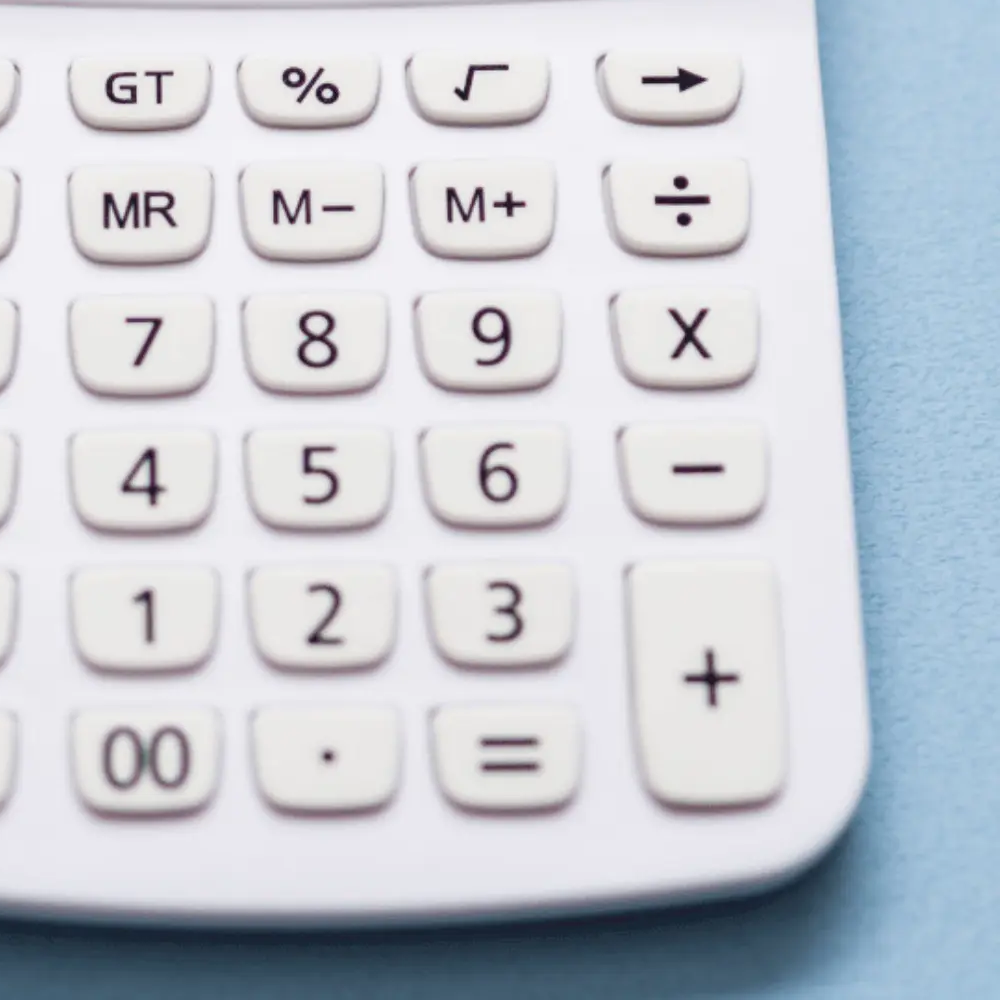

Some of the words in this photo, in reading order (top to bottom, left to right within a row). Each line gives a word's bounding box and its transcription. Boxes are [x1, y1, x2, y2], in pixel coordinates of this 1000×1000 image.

[104, 70, 175, 105] GT
[281, 66, 341, 105] %
[102, 190, 178, 230] MR
[445, 185, 527, 224] M+
[124, 316, 165, 368] 7
[296, 309, 339, 369] 8
[470, 306, 513, 368] 9
[119, 446, 167, 506] 4
[301, 445, 340, 506] 5
[478, 441, 520, 504] 6
[133, 588, 155, 644] 1
[305, 582, 347, 646] 2
[486, 580, 525, 643] 3
[102, 726, 191, 791] 00
